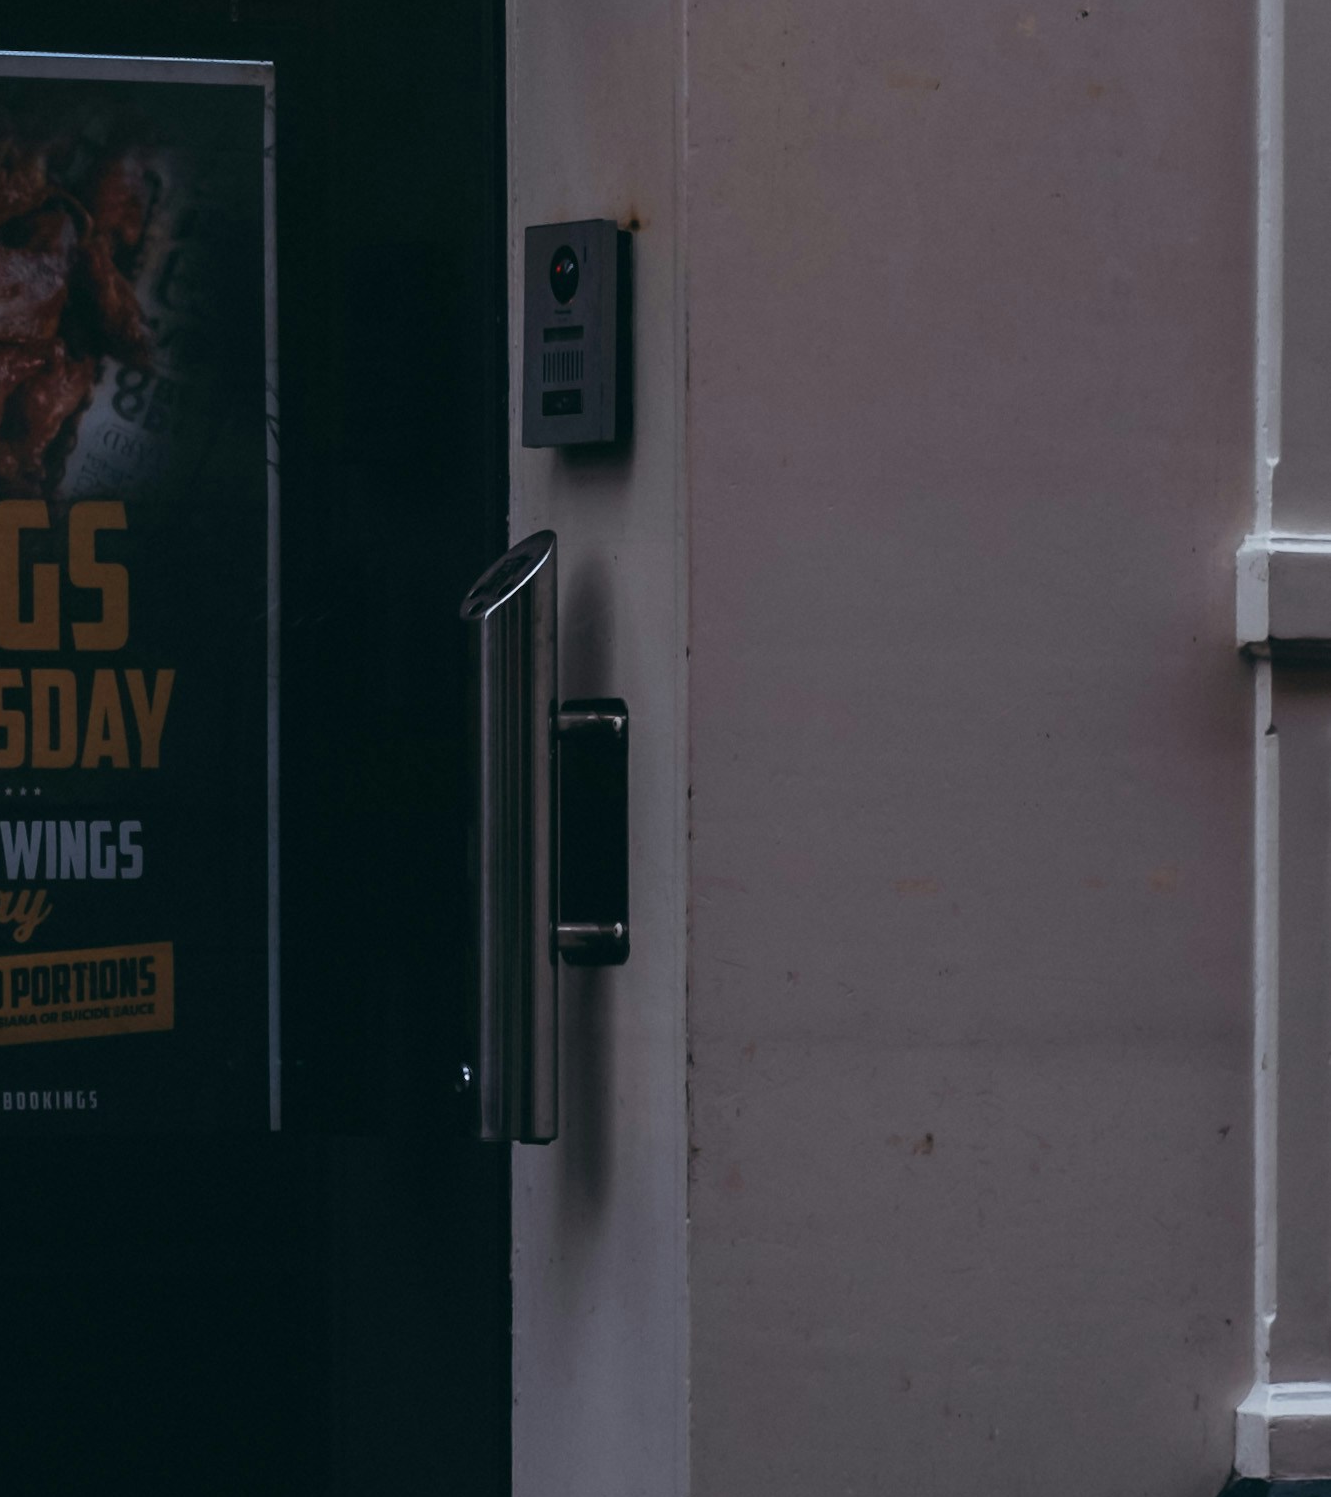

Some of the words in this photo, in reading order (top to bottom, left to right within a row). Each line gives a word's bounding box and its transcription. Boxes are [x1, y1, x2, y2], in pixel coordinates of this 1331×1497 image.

[0, 820, 144, 881] WINGS
[11, 956, 156, 1009] PORTIONS
[61, 1007, 111, 1023] SUICIDE
